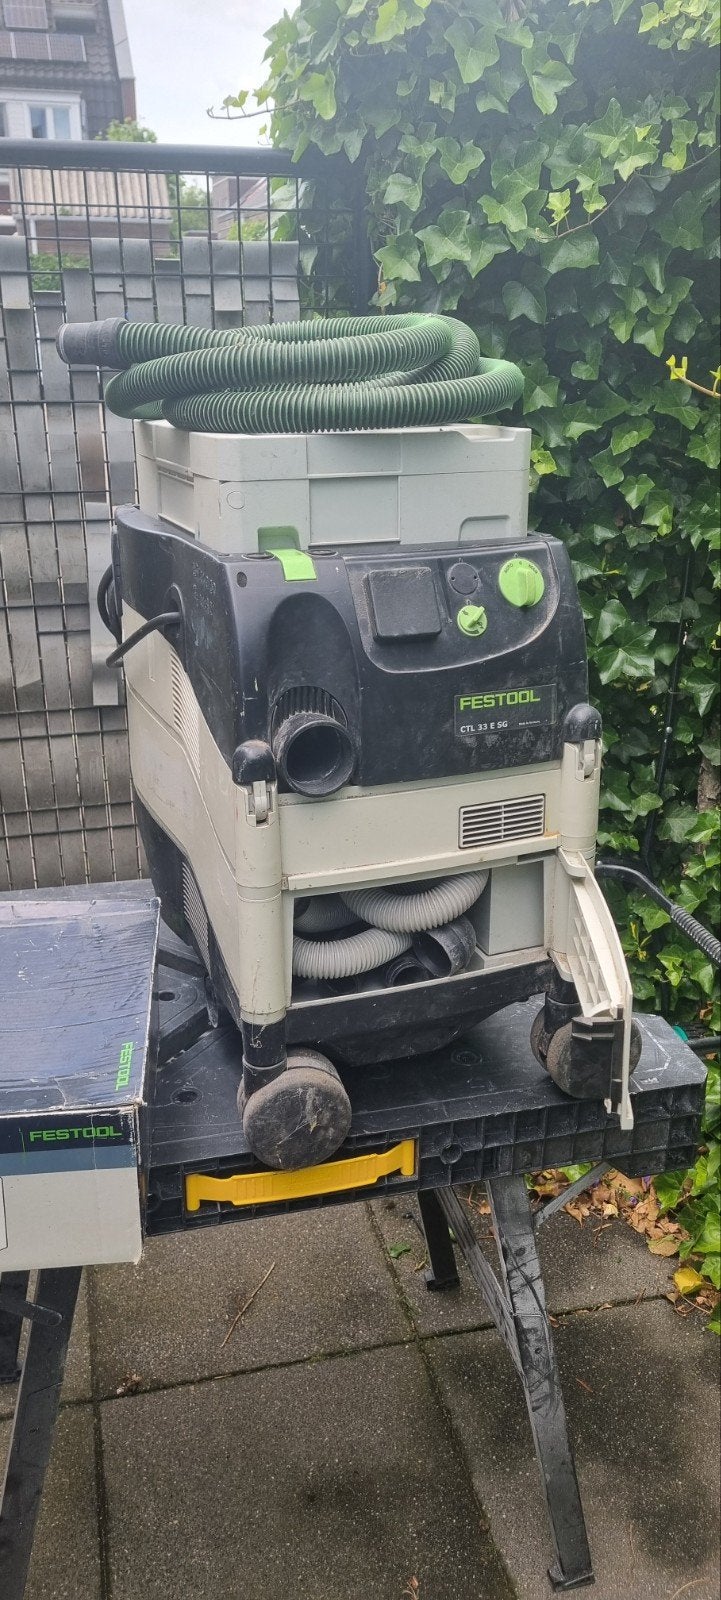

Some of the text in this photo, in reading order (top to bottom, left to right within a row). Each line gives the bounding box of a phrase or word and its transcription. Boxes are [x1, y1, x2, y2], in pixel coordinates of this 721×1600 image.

[460, 690, 540, 710] FESTOOL
[460, 725, 475, 733] CTL
[115, 1042, 134, 1091] FESTOOL
[30, 1126, 122, 1142] FESTOOL
